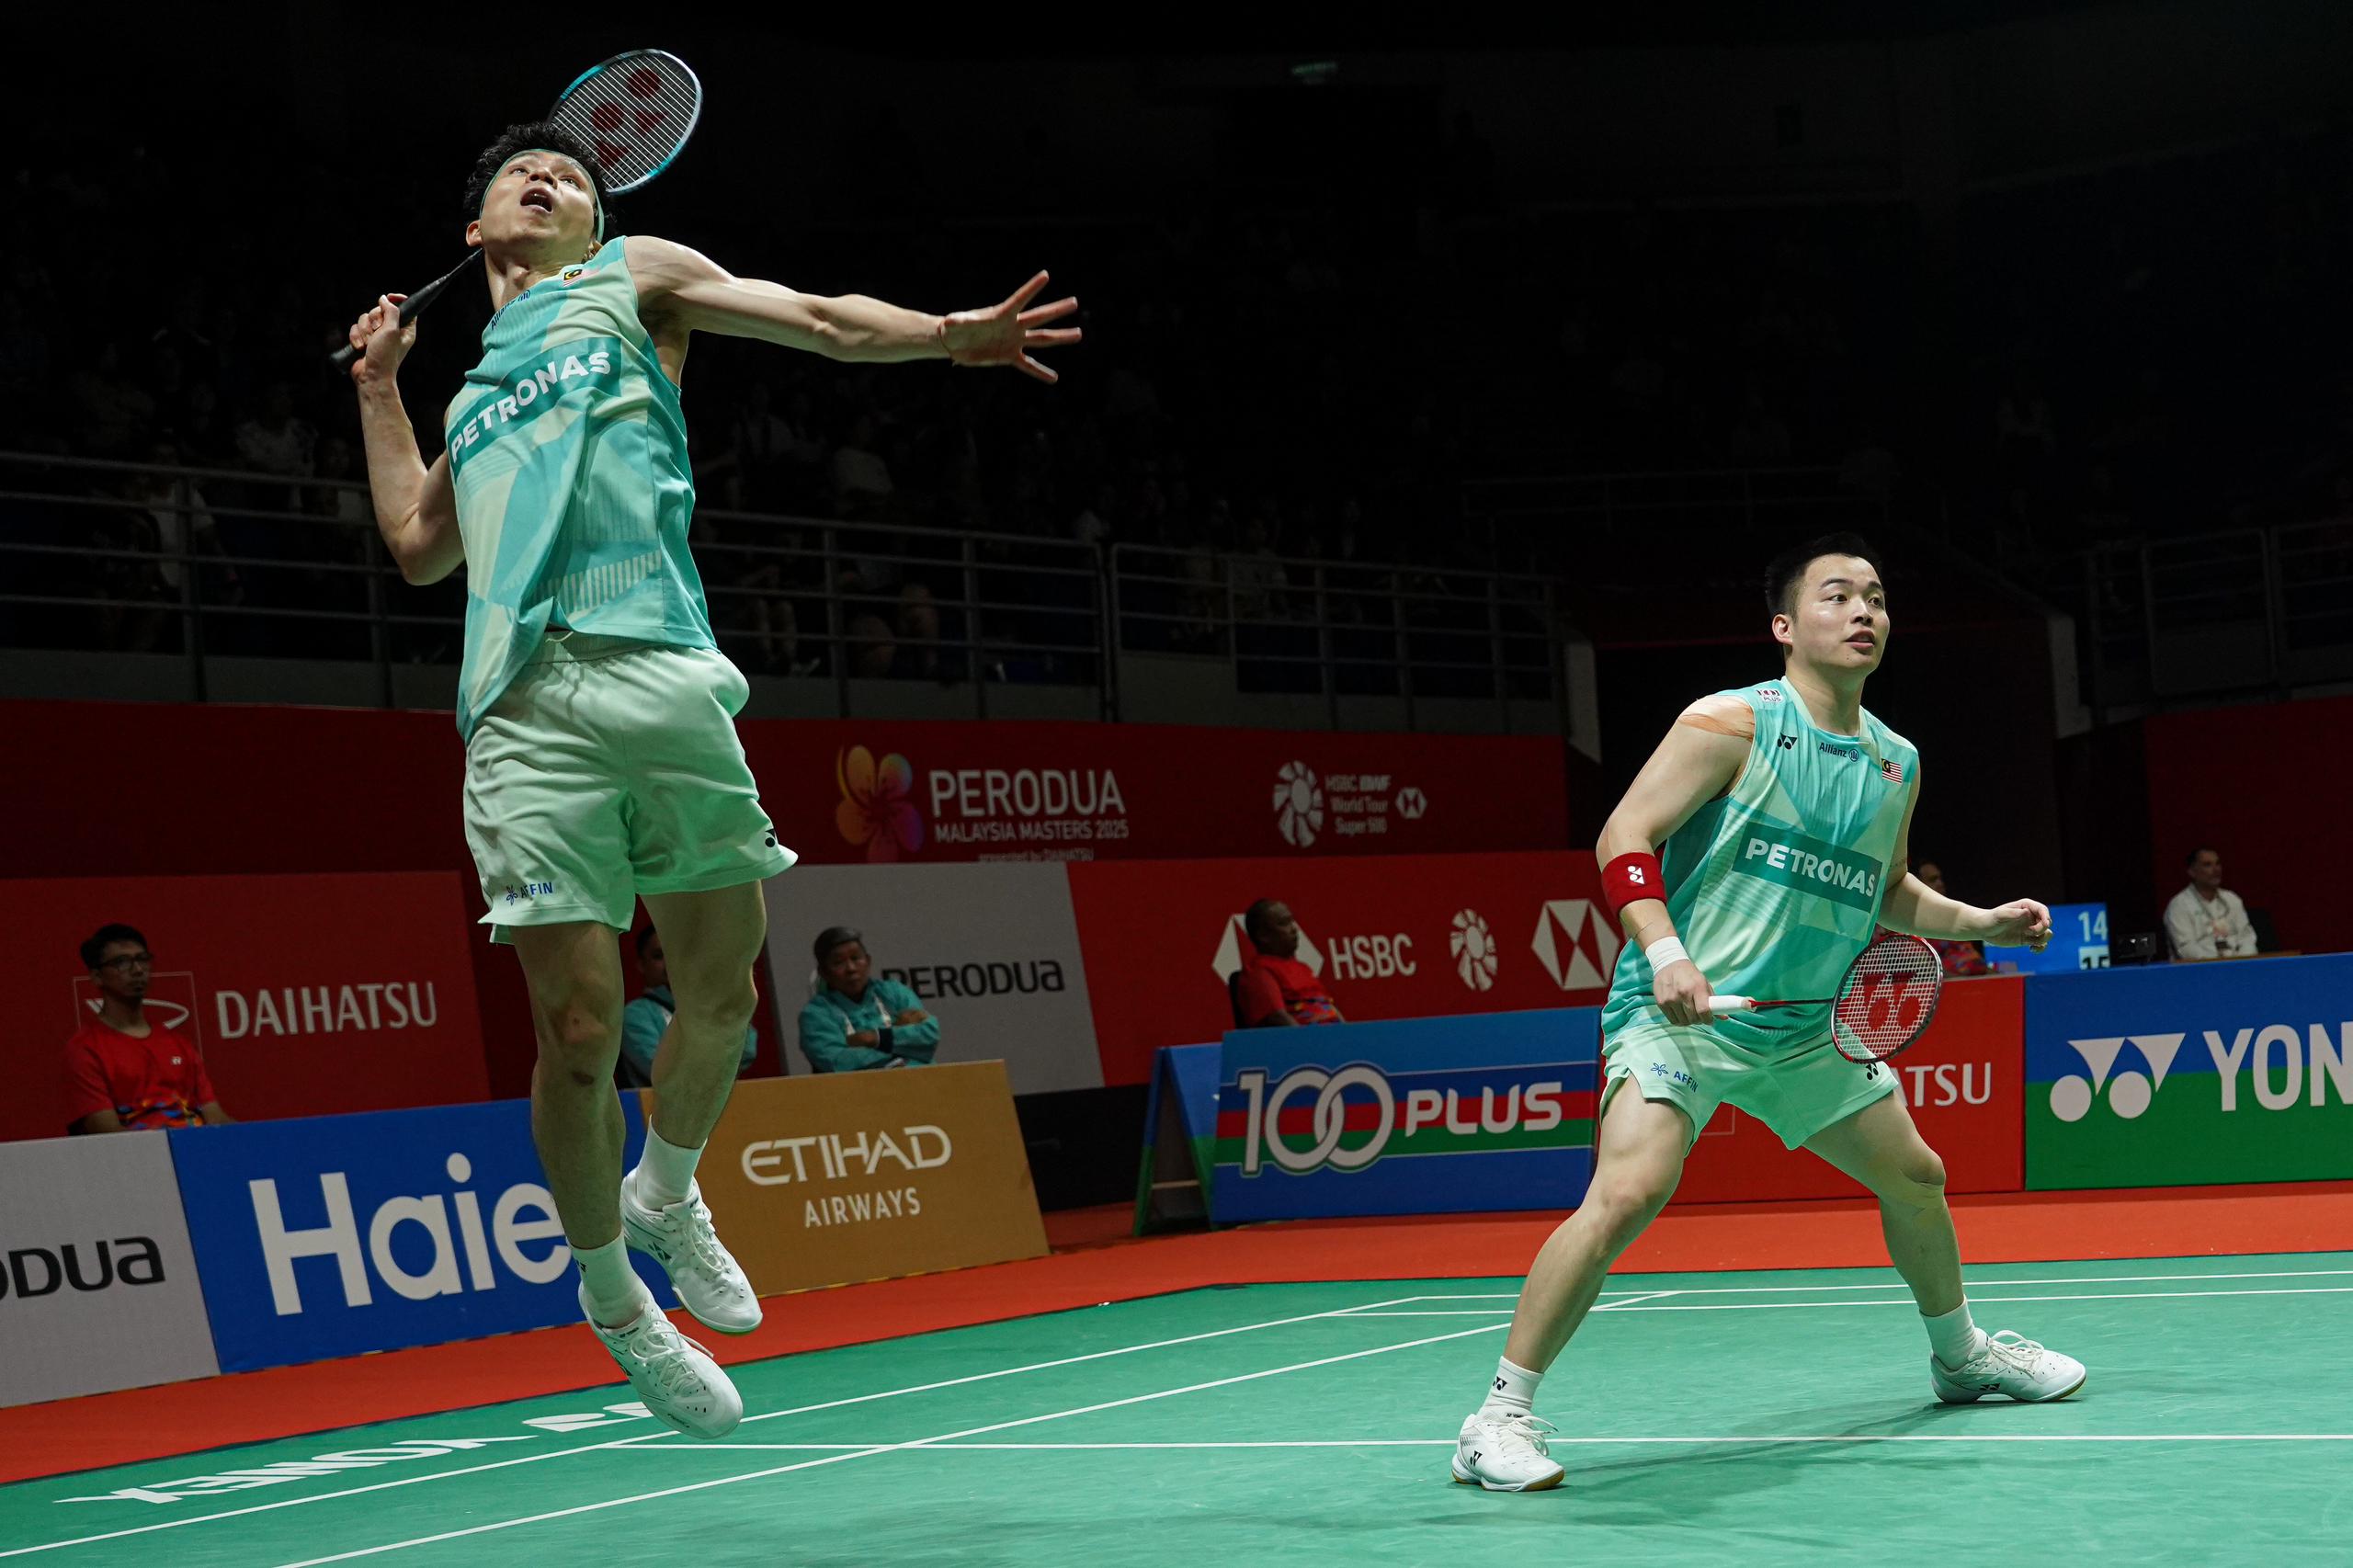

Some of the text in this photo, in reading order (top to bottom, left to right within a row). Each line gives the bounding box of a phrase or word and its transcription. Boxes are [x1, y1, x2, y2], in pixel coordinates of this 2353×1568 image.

[450, 351, 612, 464] PETRONAS
[1819, 742, 1847, 758] Allianz
[928, 769, 1126, 817] PERODUA
[934, 822, 1016, 843] MALAYSIA
[1017, 819, 1094, 841] MASTERS
[1745, 837, 1877, 898] PETRONAS
[2078, 910, 2109, 942] 14
[1328, 933, 1416, 981] HSBC
[215, 981, 438, 1040] DAIHATSU
[1674, 1071, 1699, 1093] AFFIN
[1238, 1064, 1563, 1173] 100 PLUS
[741, 1124, 952, 1186] ETIHAD
[249, 1152, 572, 1316] Haie
[804, 1187, 920, 1229] AIRWAYS
[53, 1434, 540, 1505] YONEX
